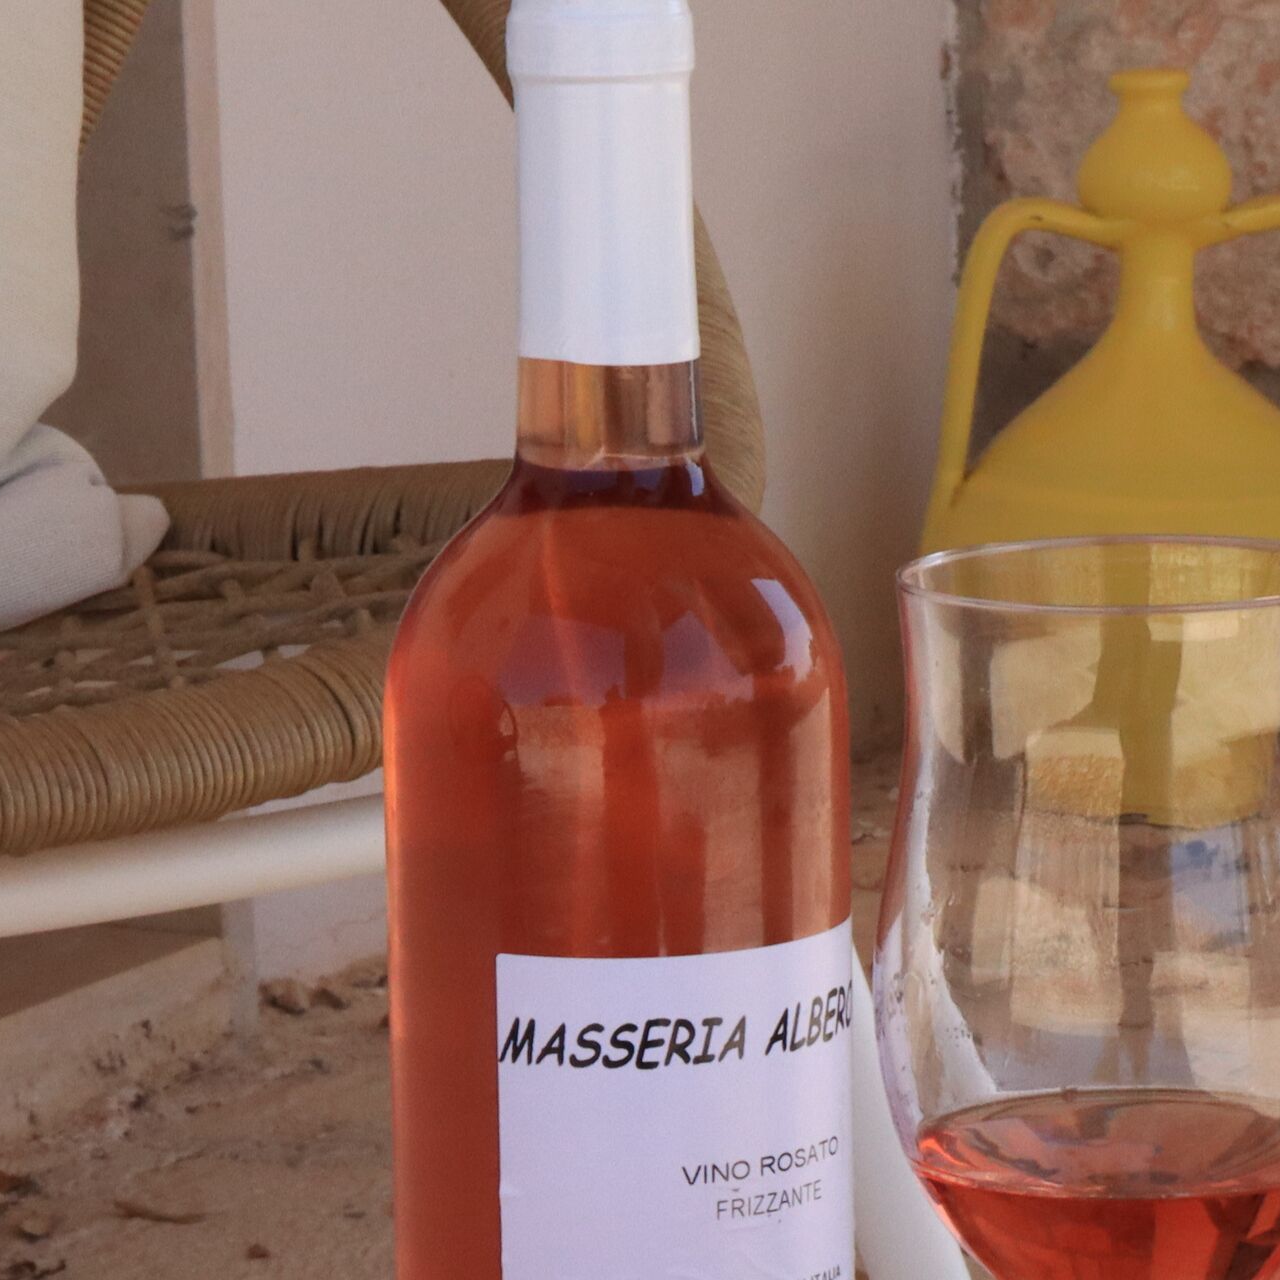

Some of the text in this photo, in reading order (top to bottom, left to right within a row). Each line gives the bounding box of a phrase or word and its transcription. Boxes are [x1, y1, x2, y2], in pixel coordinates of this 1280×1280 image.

[499, 1015, 746, 1069] MASSERIA
[682, 1135, 839, 1186] VINO ROSATO
[716, 1179, 823, 1220] FRIZZANTE
